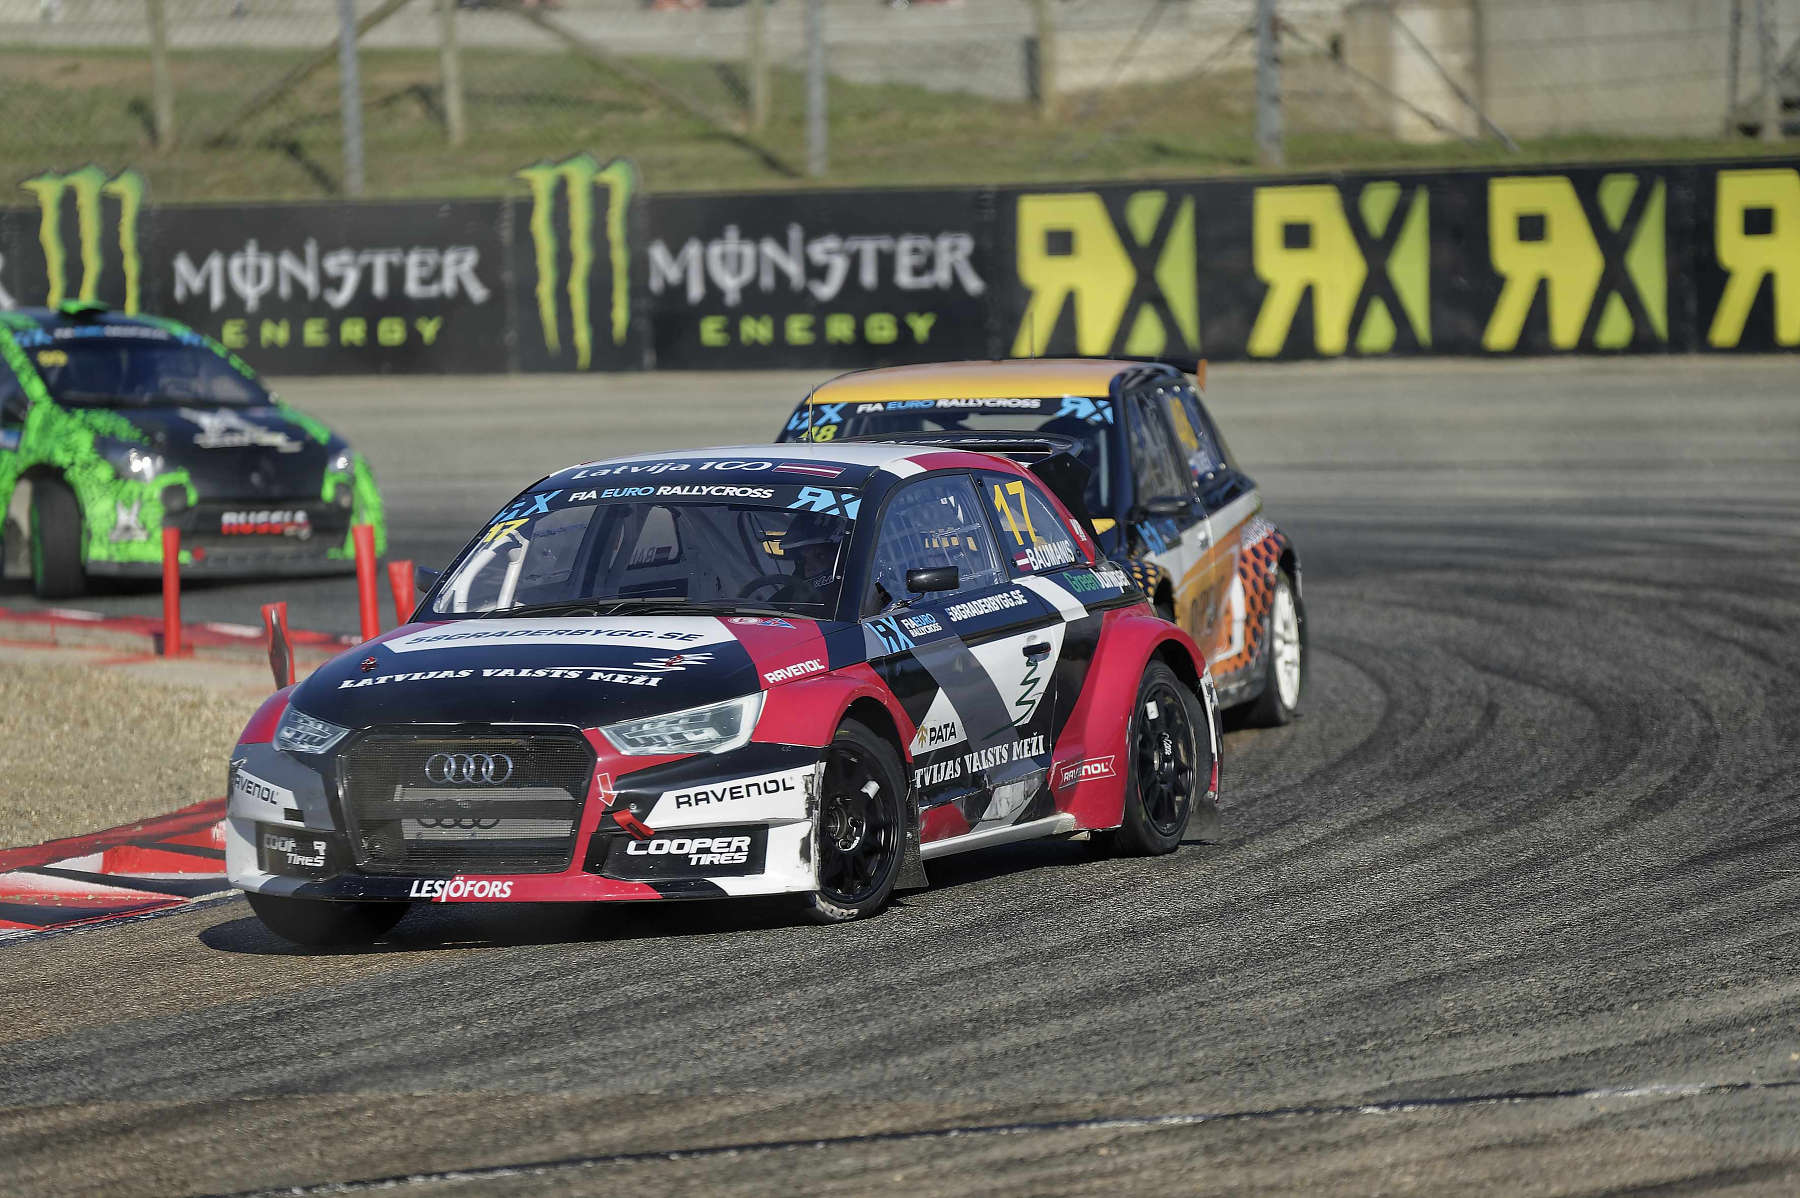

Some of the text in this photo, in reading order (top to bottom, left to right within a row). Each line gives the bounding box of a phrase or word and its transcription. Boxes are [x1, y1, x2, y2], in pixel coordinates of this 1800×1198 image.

[221, 316, 442, 348] ENERGY
[700, 313, 937, 347] ENERGY
[856, 398, 1042, 414] FIA EURO RALLYCROSS
[571, 461, 693, 480] Latvija
[568, 486, 776, 502] FIA EURO RALLYCROSS
[993, 480, 1037, 546] 17
[483, 518, 530, 543] 17
[909, 622, 943, 638] RALLYCROSS
[337, 668, 663, 689] LATVIJAS VALSTS MEŽI
[763, 658, 826, 684] RAVENOL
[929, 722, 957, 746] PATA
[962, 742, 1010, 774] VALSTS
[1011, 732, 1046, 761] MEŽI
[1063, 763, 1110, 782] RAVENOL
[233, 773, 279, 806] AVENOL
[675, 777, 796, 809] RAVENOL
[626, 836, 751, 856] COOPER
[287, 852, 326, 867] TIRES
[688, 851, 749, 866] TIRES
[409, 876, 514, 902] LESJÖFORS
